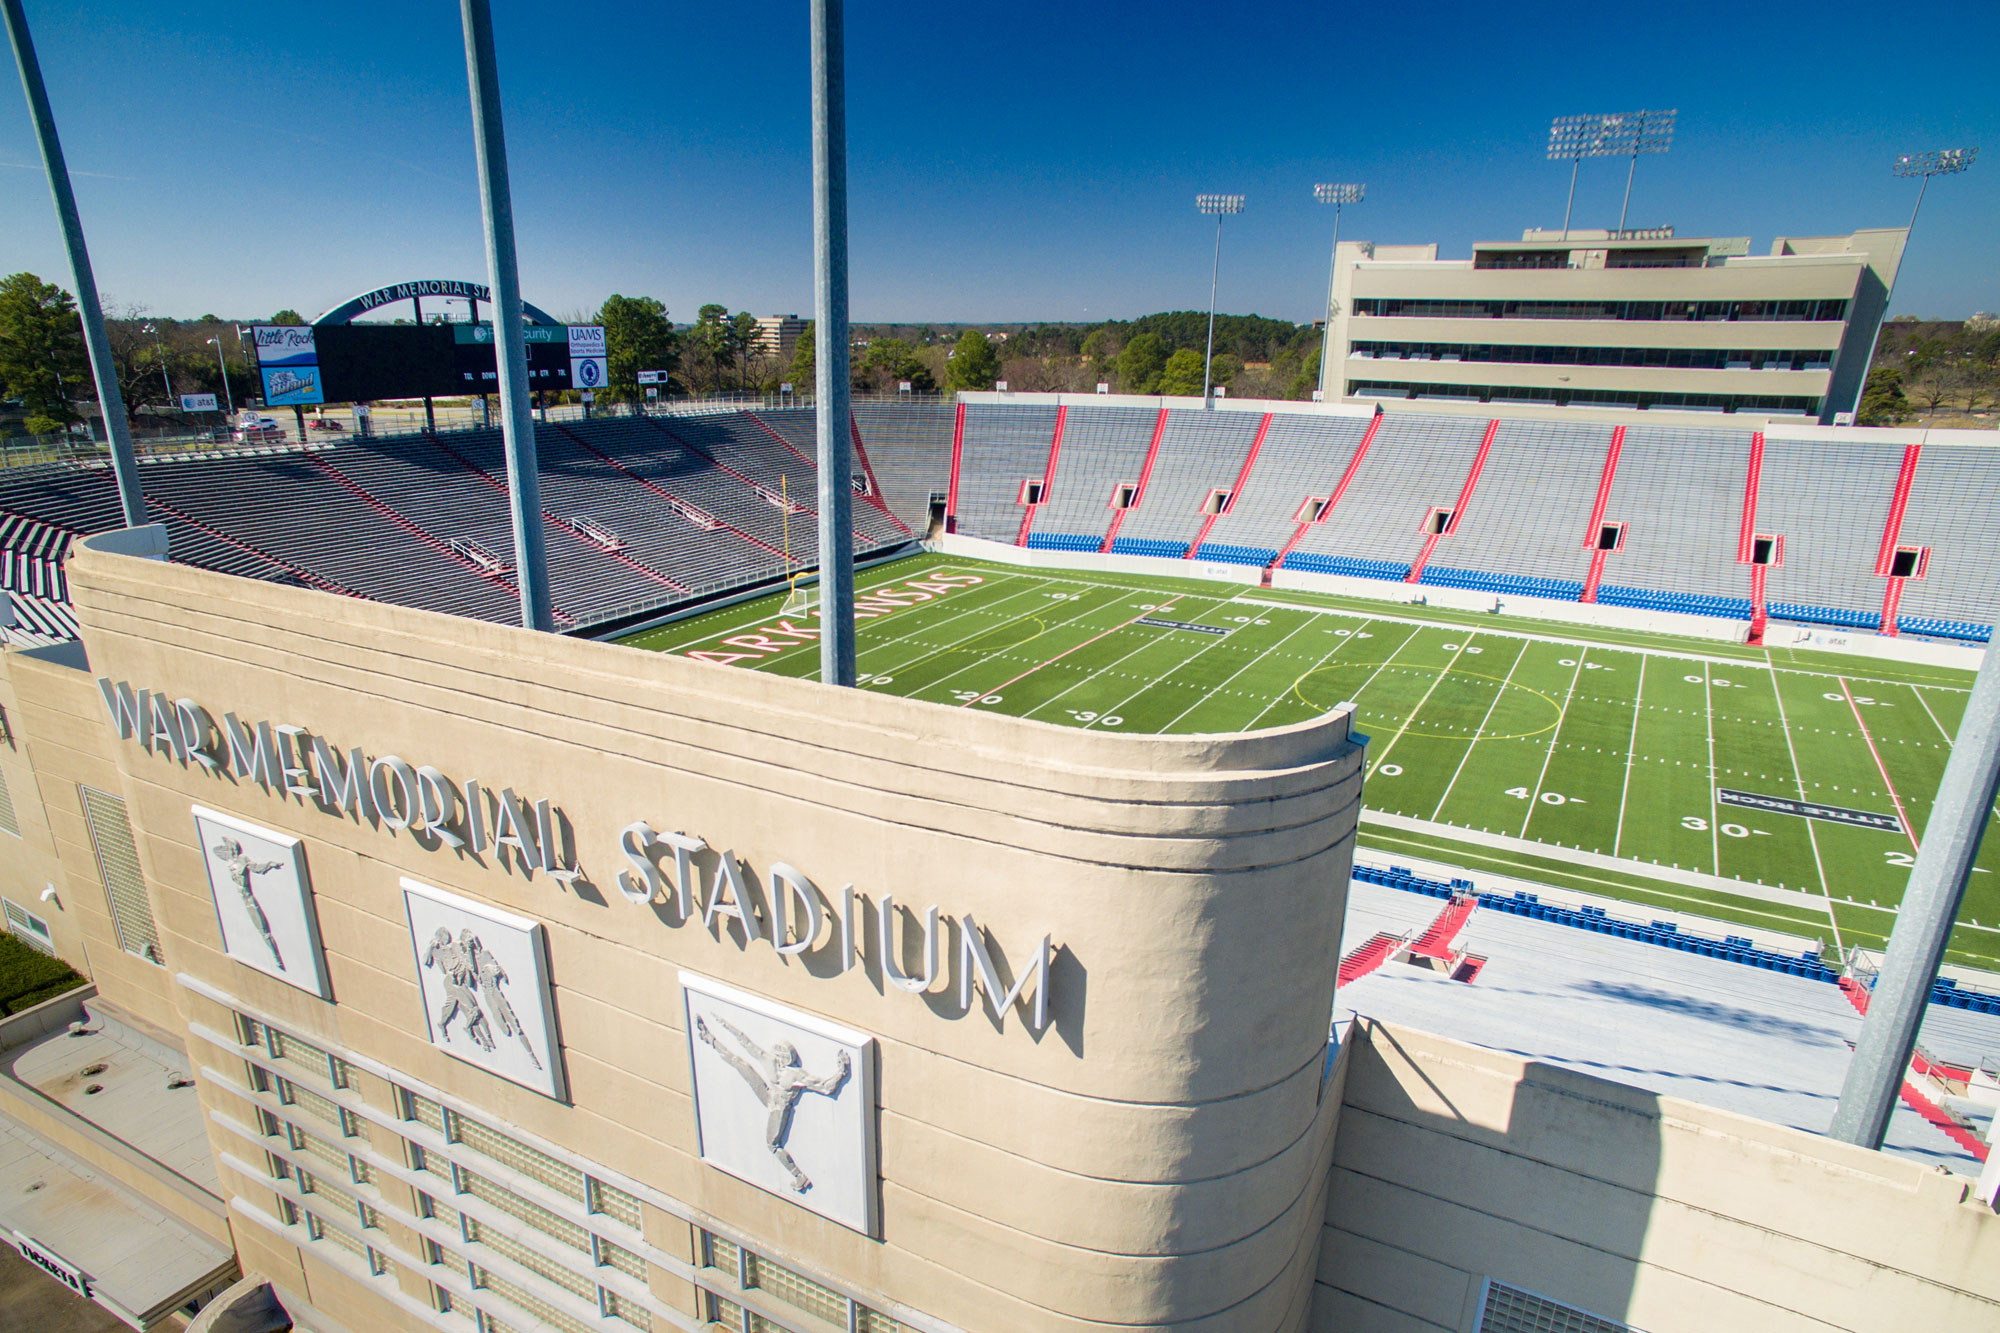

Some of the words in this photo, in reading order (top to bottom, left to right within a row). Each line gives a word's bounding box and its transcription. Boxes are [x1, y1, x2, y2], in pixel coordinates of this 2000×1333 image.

[359, 288, 393, 310] WAR
[397, 280, 469, 299] MEMORIAL
[256, 329, 284, 347] Little
[285, 329, 313, 347] Rock
[522, 327, 553, 342] curity
[571, 328, 602, 341] UAMS
[197, 398, 215, 407] at&t
[1233, 615, 1271, 626] 30
[1334, 629, 1374, 639] 40
[1442, 643, 1484, 654] 50
[1558, 659, 1603, 670] 40
[1683, 675, 1732, 687] 30
[953, 690, 1004, 705] 20
[1822, 693, 1877, 706] 20
[1074, 711, 1124, 726] 30
[1504, 786, 1566, 806] 40
[1720, 792, 1795, 811] ROCK
[1802, 806, 1901, 829] LITTLE
[1680, 816, 1750, 838] 30
[98, 676, 219, 769] WAR
[224, 711, 580, 883] MEMORIAL
[616, 820, 1051, 1030] STADIUM
[18, 1240, 80, 1290] TICKETS
